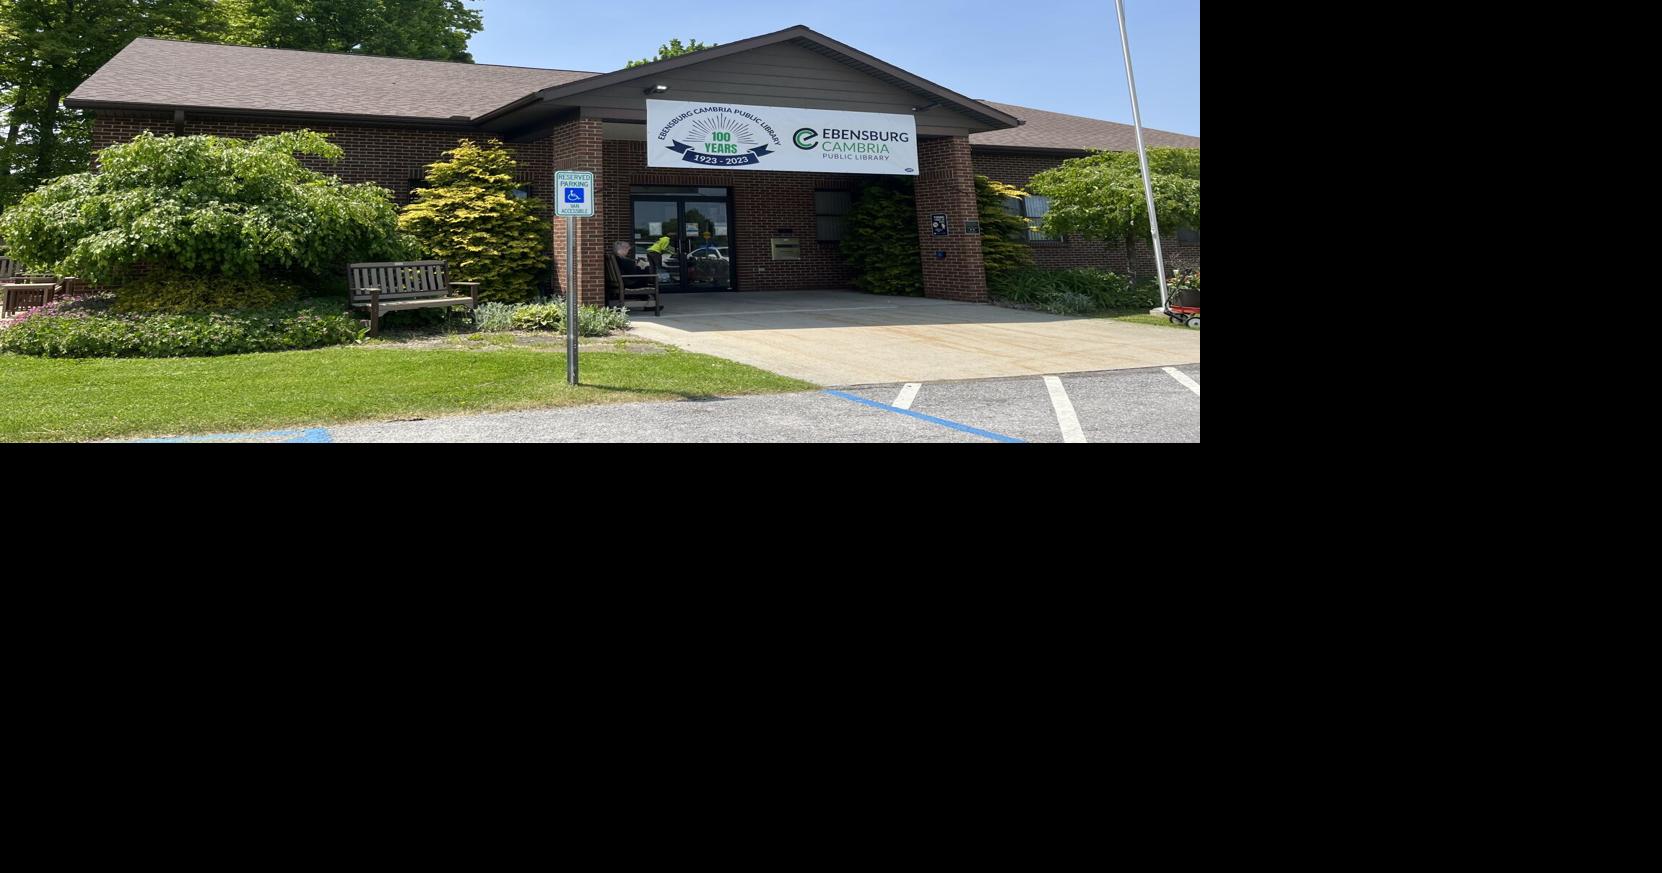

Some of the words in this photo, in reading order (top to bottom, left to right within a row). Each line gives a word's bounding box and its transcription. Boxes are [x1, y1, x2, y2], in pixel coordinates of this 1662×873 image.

[658, 110, 693, 140] EBENSBURG
[693, 106, 732, 115] CAMBRIA
[734, 109, 763, 124] PUBLIC
[760, 122, 781, 146] LIBRARY
[712, 131, 731, 142] 100
[822, 128, 909, 143] EBENSBURG
[704, 142, 738, 154] YEARS
[822, 141, 890, 154] CAMBRIA
[694, 154, 717, 165] 1923
[726, 155, 749, 165] 2023
